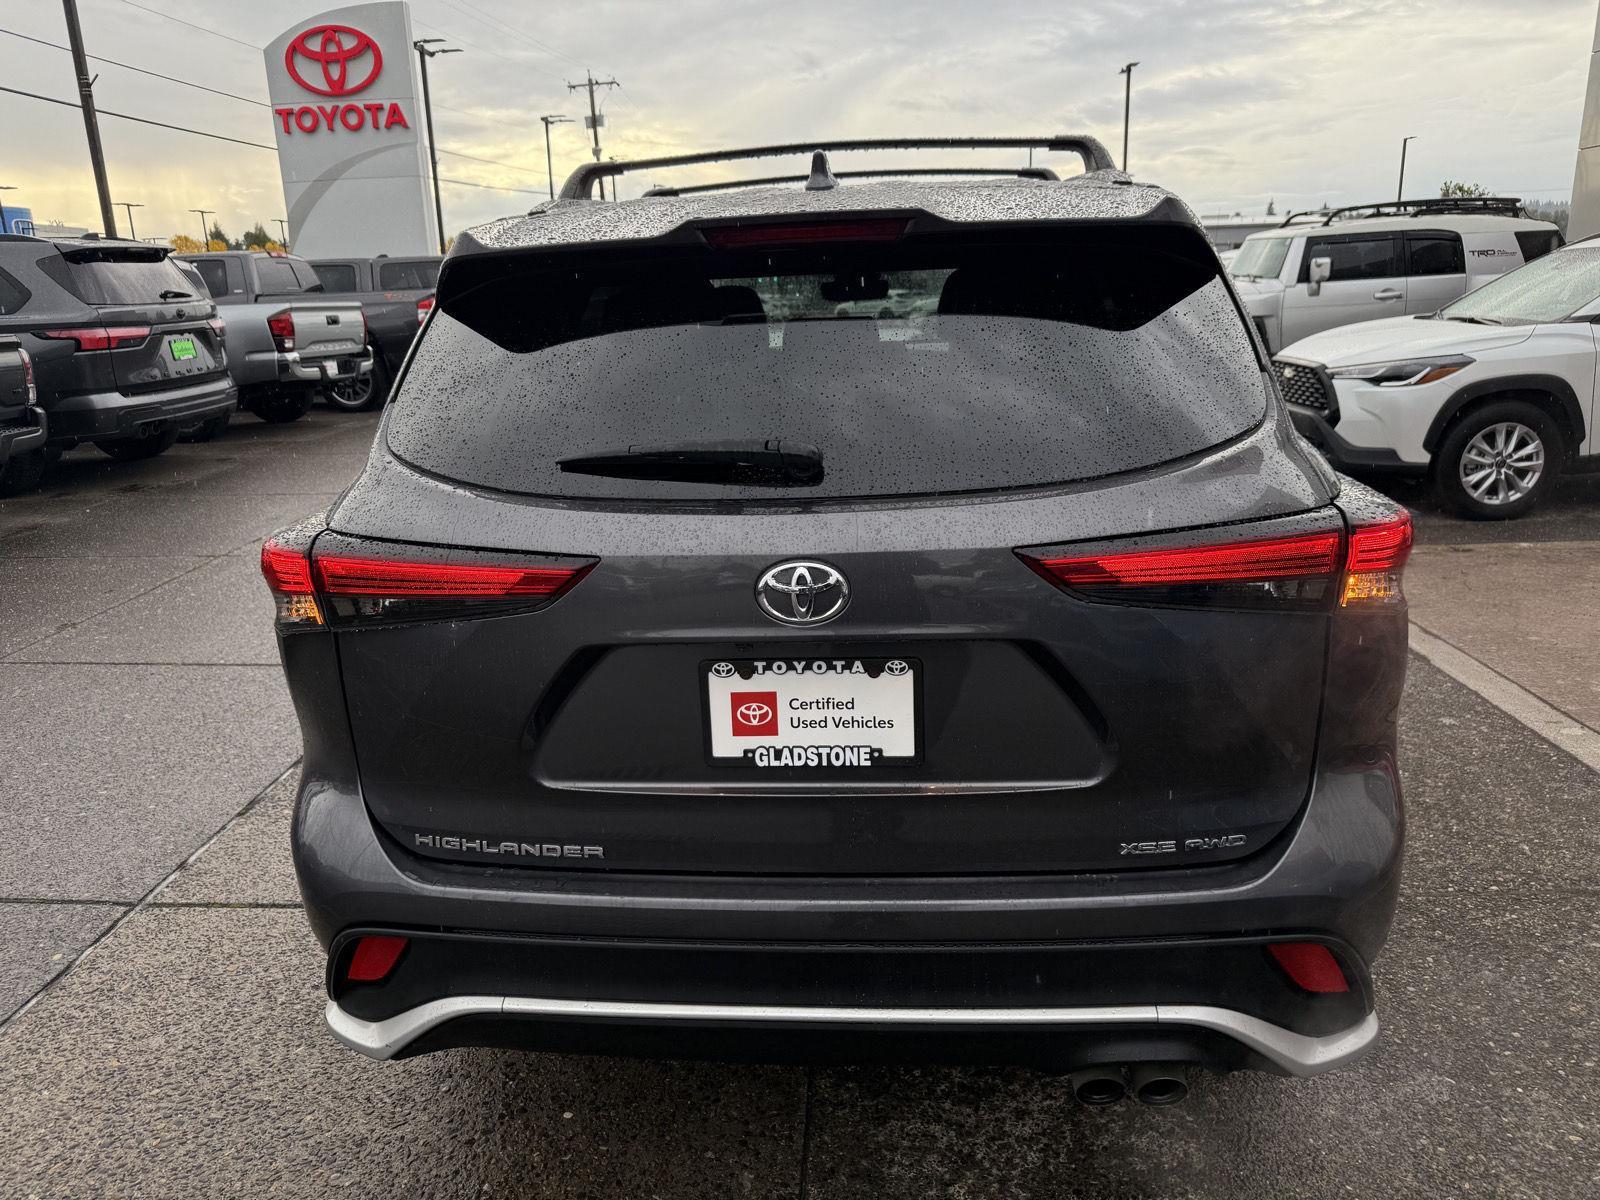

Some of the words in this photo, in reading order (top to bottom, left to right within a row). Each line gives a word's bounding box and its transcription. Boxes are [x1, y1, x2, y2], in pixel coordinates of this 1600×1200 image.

[275, 102, 410, 135] TOYOTA
[754, 660, 866, 676] TOYOTA
[788, 698, 855, 711] Certified
[790, 716, 828, 729] Used
[832, 716, 895, 729] Vehicles
[754, 746, 872, 767] GLADSTONE
[414, 833, 605, 859] HIGHLANDER
[1119, 840, 1177, 855] XSE
[1184, 834, 1248, 852] AWD
